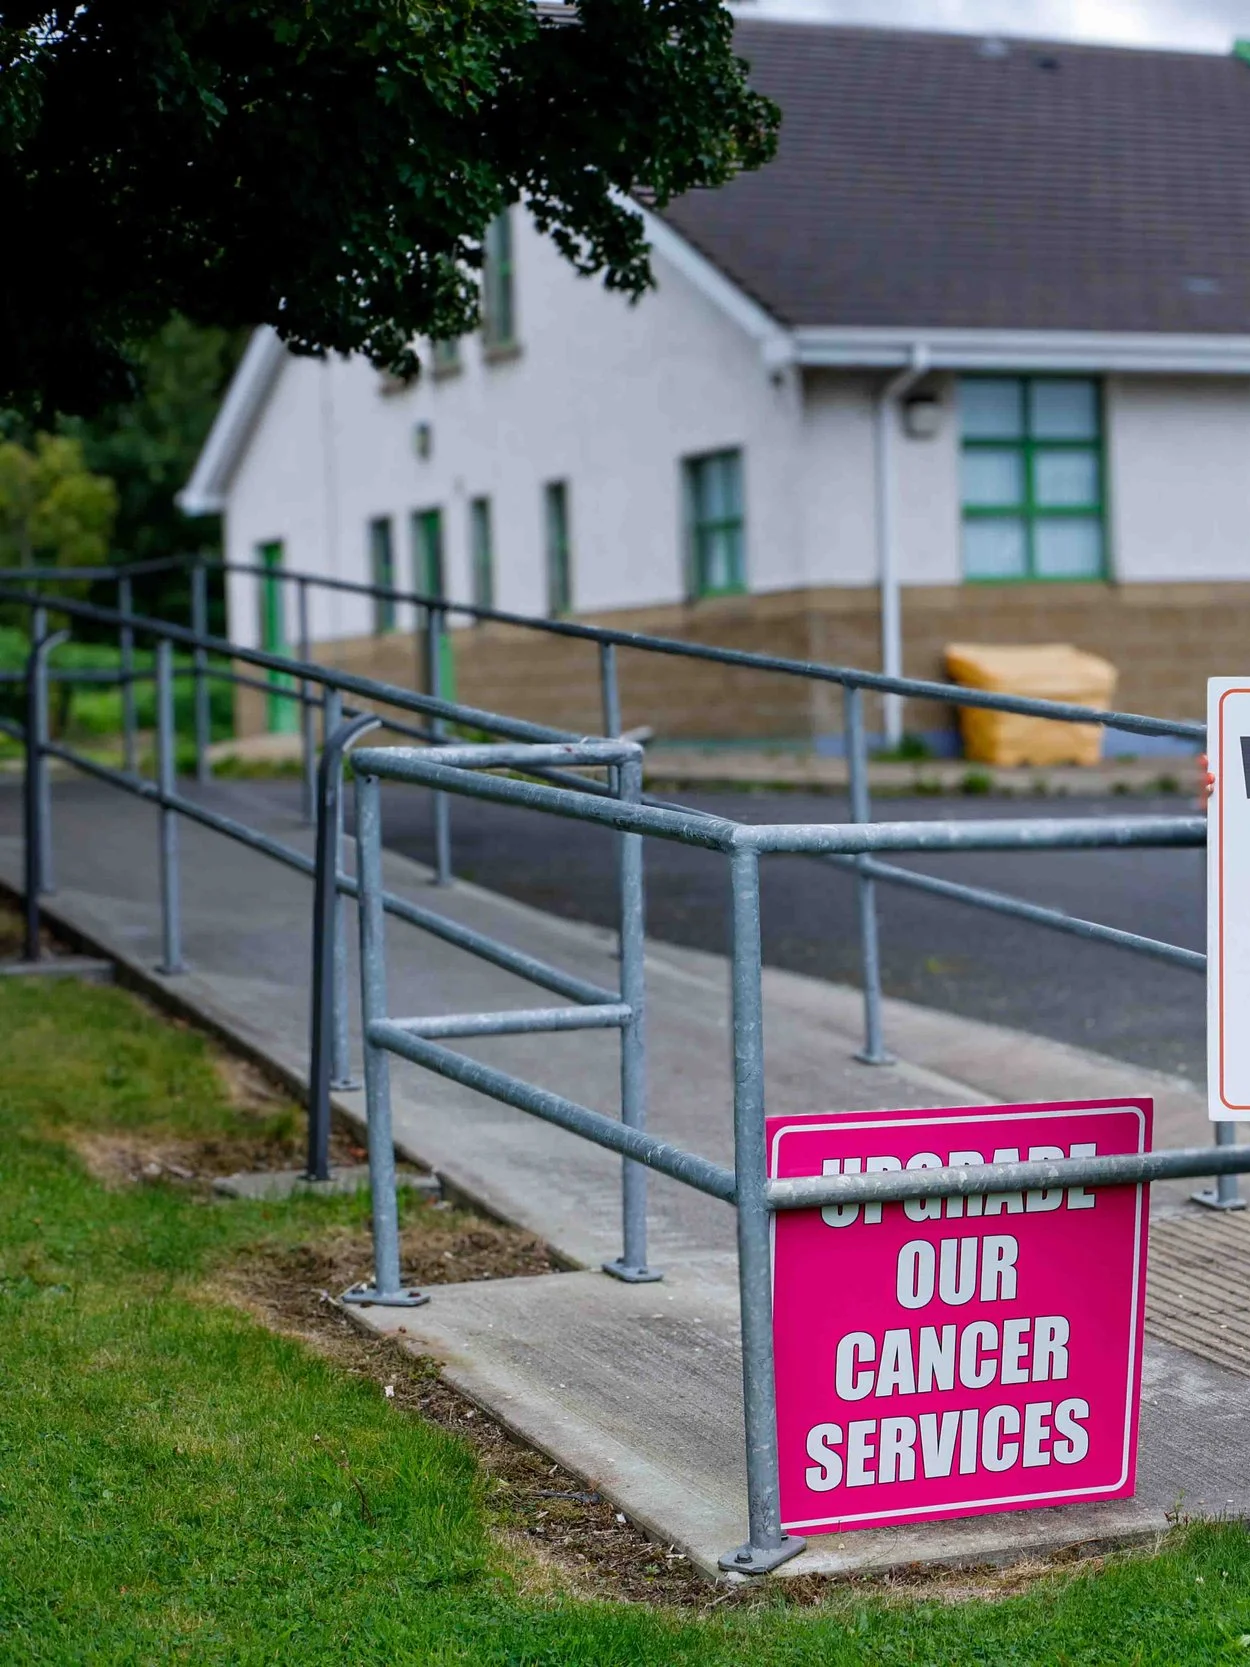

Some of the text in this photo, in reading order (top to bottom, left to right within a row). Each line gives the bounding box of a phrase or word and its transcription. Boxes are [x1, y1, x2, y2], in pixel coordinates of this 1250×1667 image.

[895, 1235, 1019, 1309] OUR
[834, 1315, 1071, 1401] CANCER
[804, 1398, 1090, 1492] SERVICES
